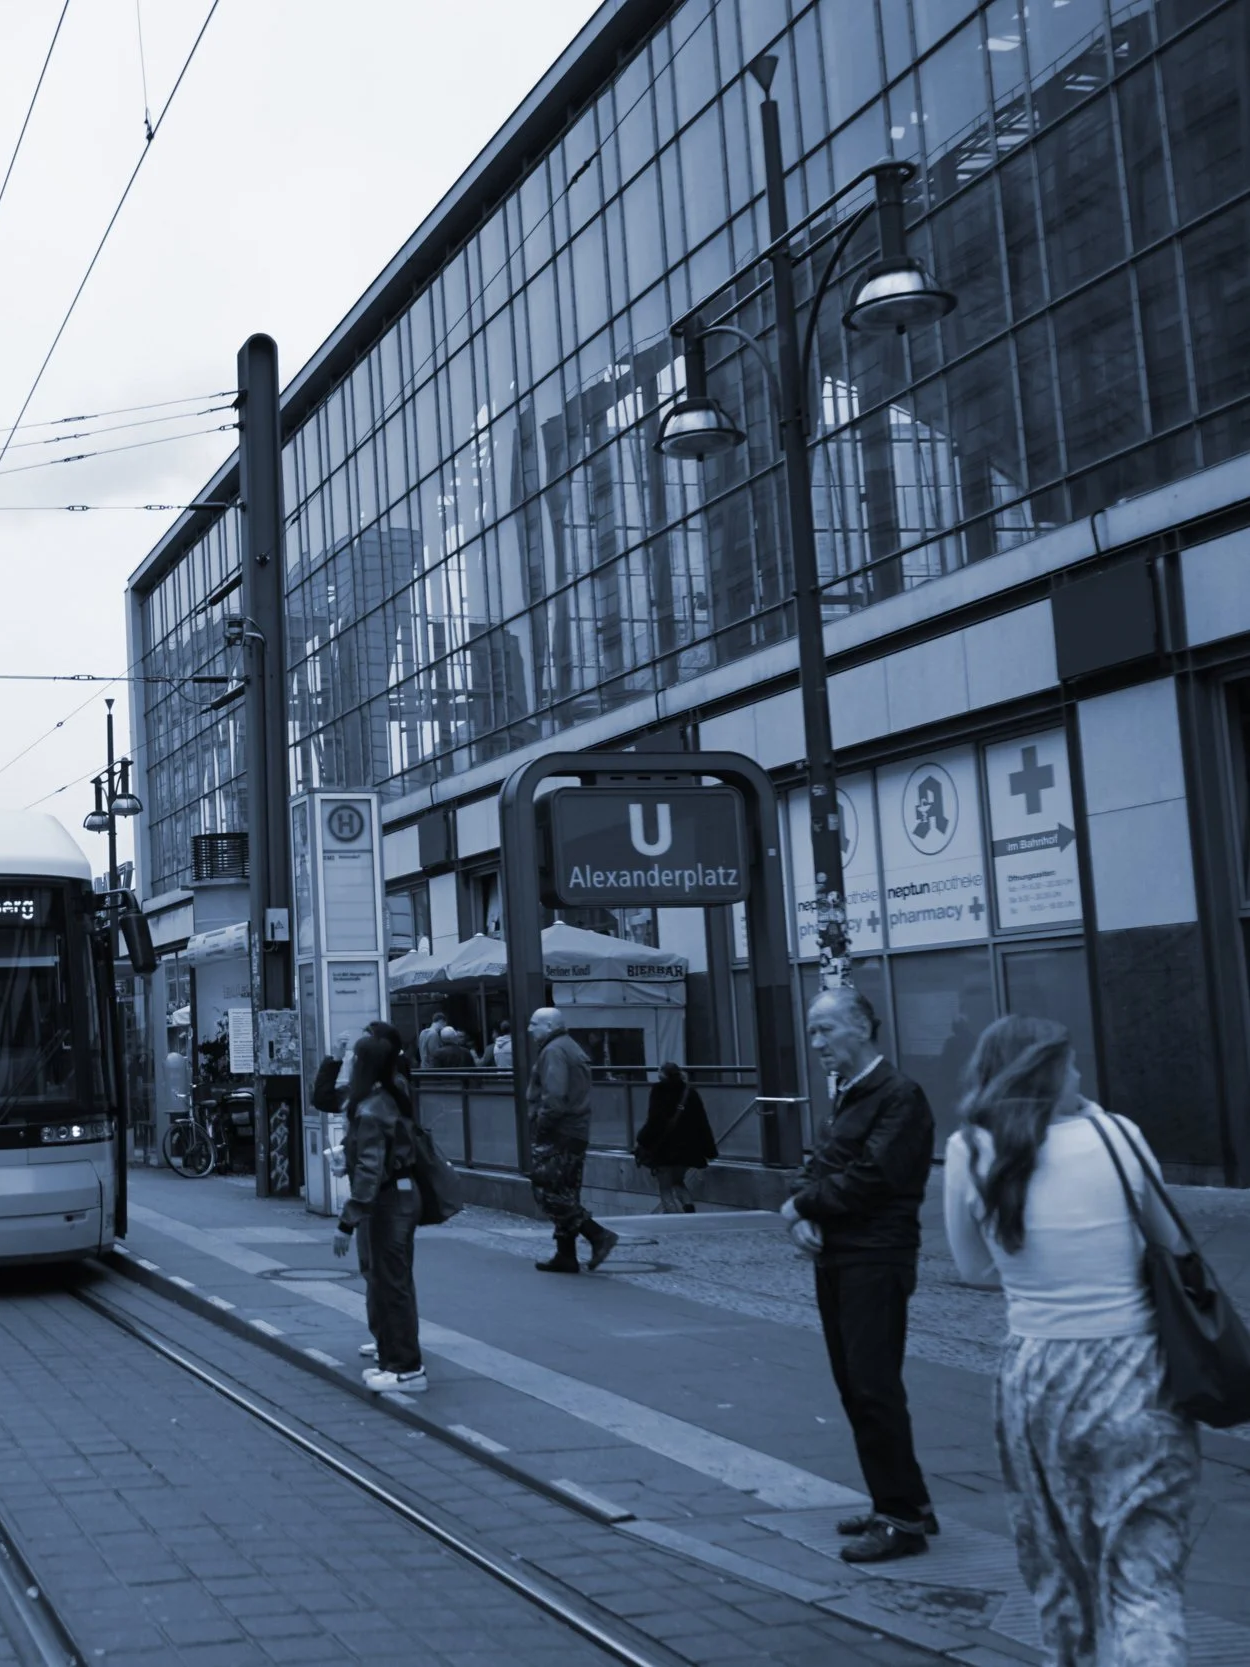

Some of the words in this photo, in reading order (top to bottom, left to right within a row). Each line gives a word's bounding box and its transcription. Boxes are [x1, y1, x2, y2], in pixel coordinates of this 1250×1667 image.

[628, 803, 672, 857] U
[1019, 833, 1058, 850] Bahnhof
[569, 863, 738, 893] Alexanderplatz
[889, 904, 963, 929] pharmacy
[627, 965, 683, 978] BIERBAR
